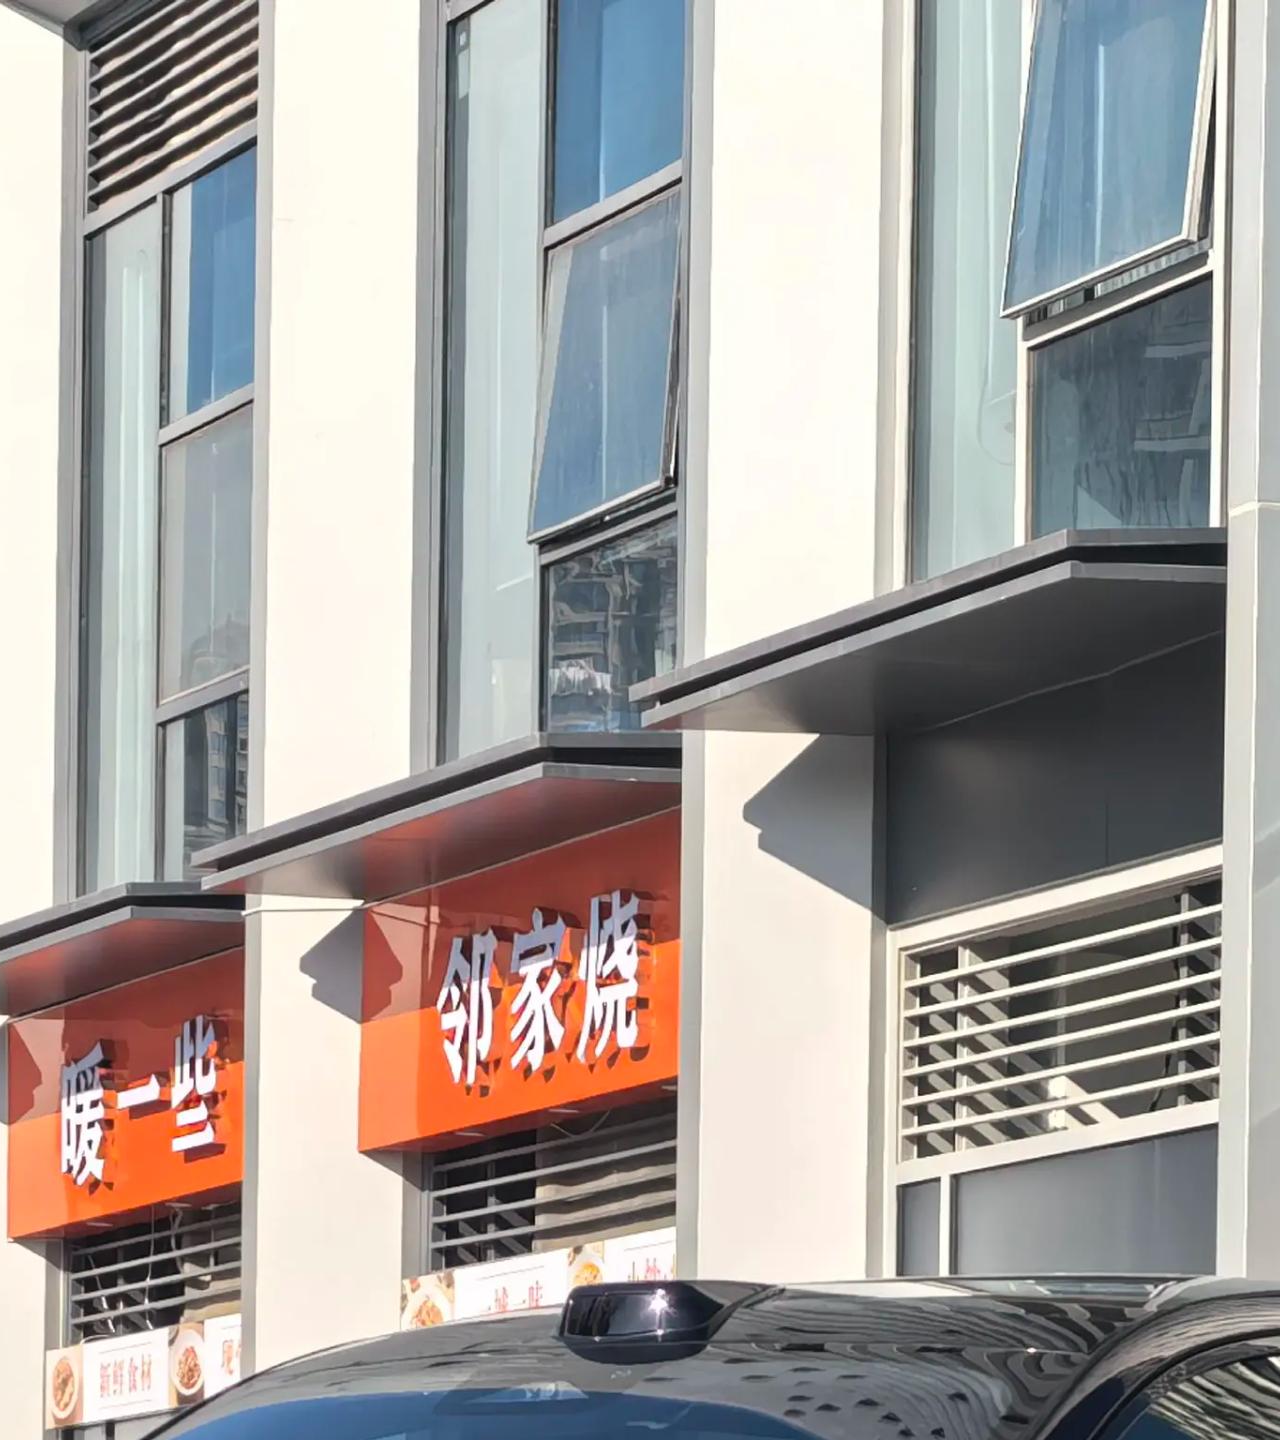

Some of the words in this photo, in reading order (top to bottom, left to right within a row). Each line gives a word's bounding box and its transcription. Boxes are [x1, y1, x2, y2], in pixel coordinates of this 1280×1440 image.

[436, 889, 640, 1085] 邻家烧
[61, 1014, 217, 1187] 暖一些
